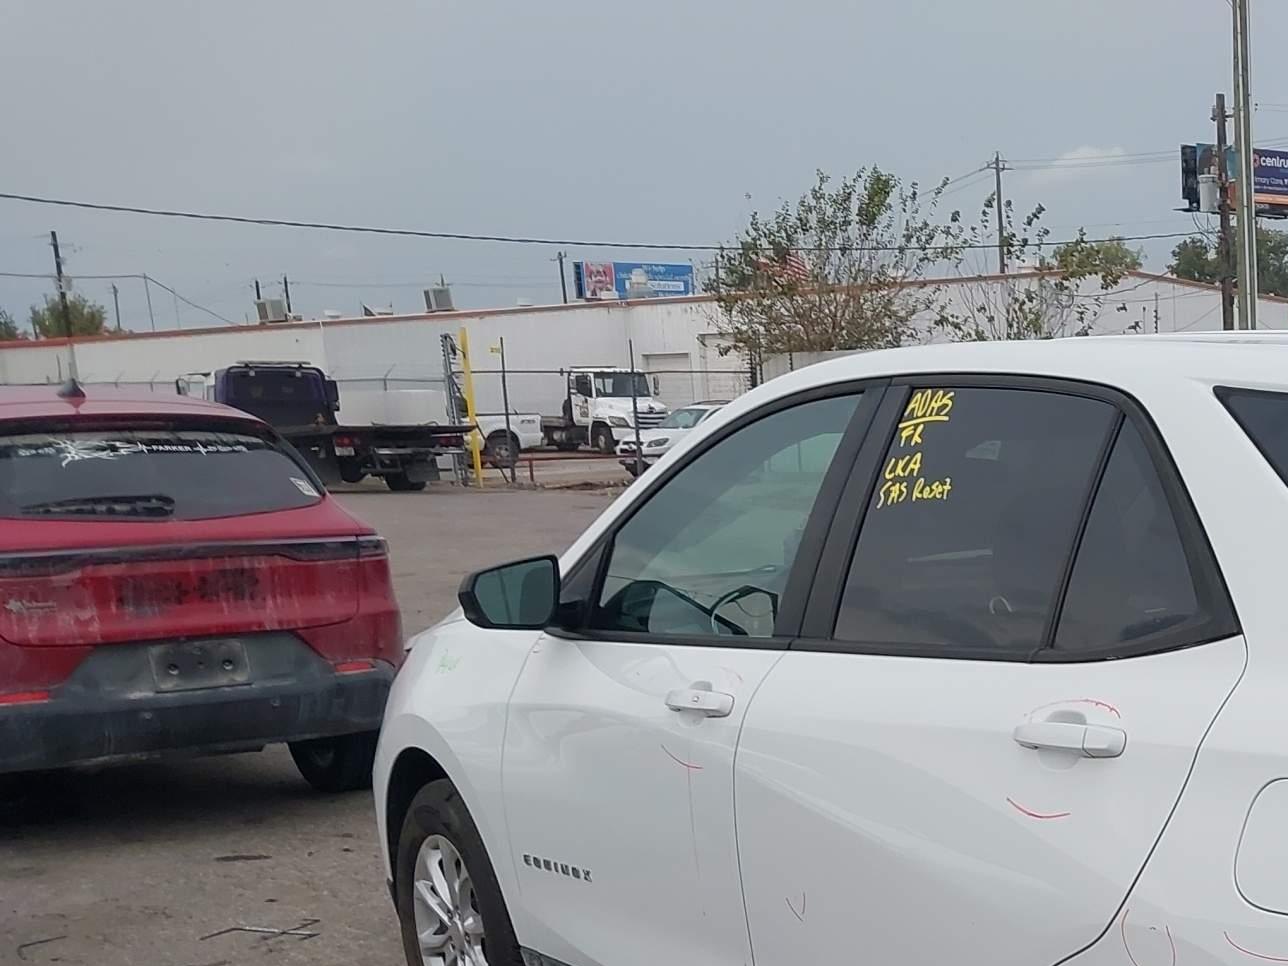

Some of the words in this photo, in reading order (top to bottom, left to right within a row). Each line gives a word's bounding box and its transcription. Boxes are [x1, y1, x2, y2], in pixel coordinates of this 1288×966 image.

[904, 389, 954, 417] ADAS
[152, 444, 192, 453] PARKER
[884, 451, 923, 480] LKA
[912, 478, 952, 501] Reset
[523, 854, 592, 882] EQUINOX
